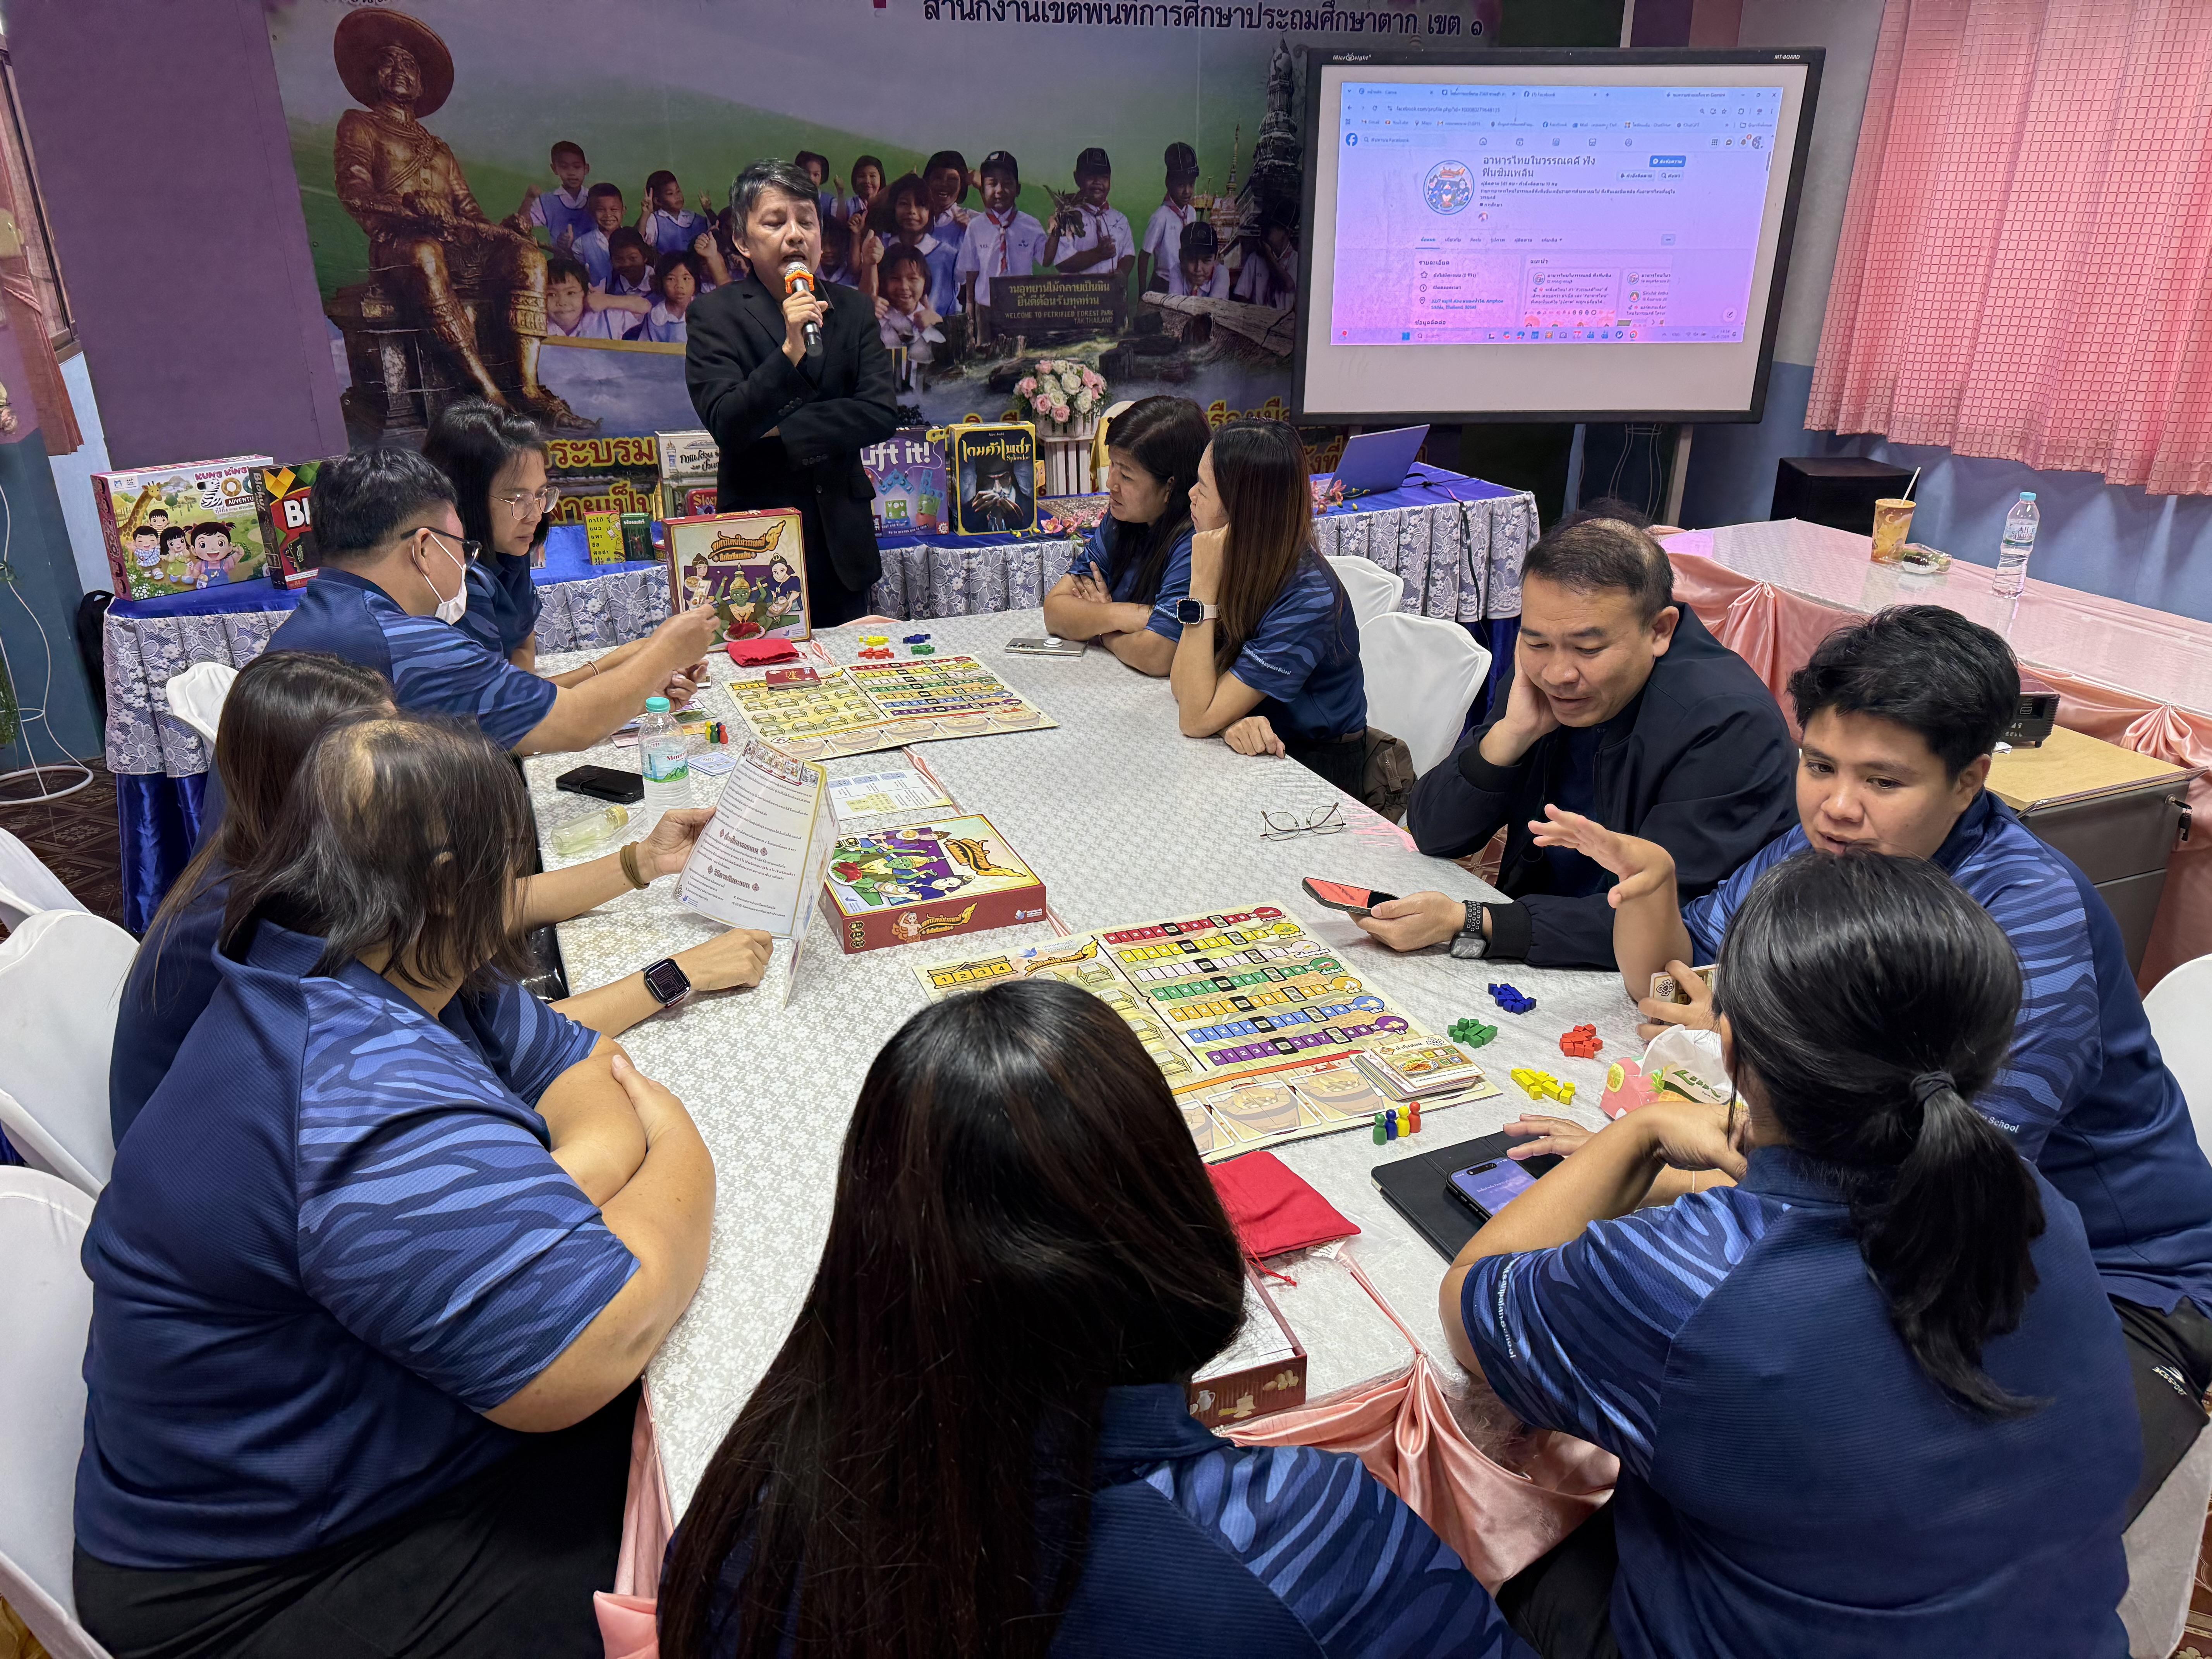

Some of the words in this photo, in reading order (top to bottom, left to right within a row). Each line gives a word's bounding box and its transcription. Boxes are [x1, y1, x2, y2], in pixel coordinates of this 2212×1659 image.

[1428, 13, 1461, 36] เขต
[544, 439, 654, 465] ระบรม
[905, 440, 930, 464] it!
[1006, 455, 1030, 463] Splendor
[195, 471, 223, 481] KUNG
[1988, 1116, 2020, 1133] School
